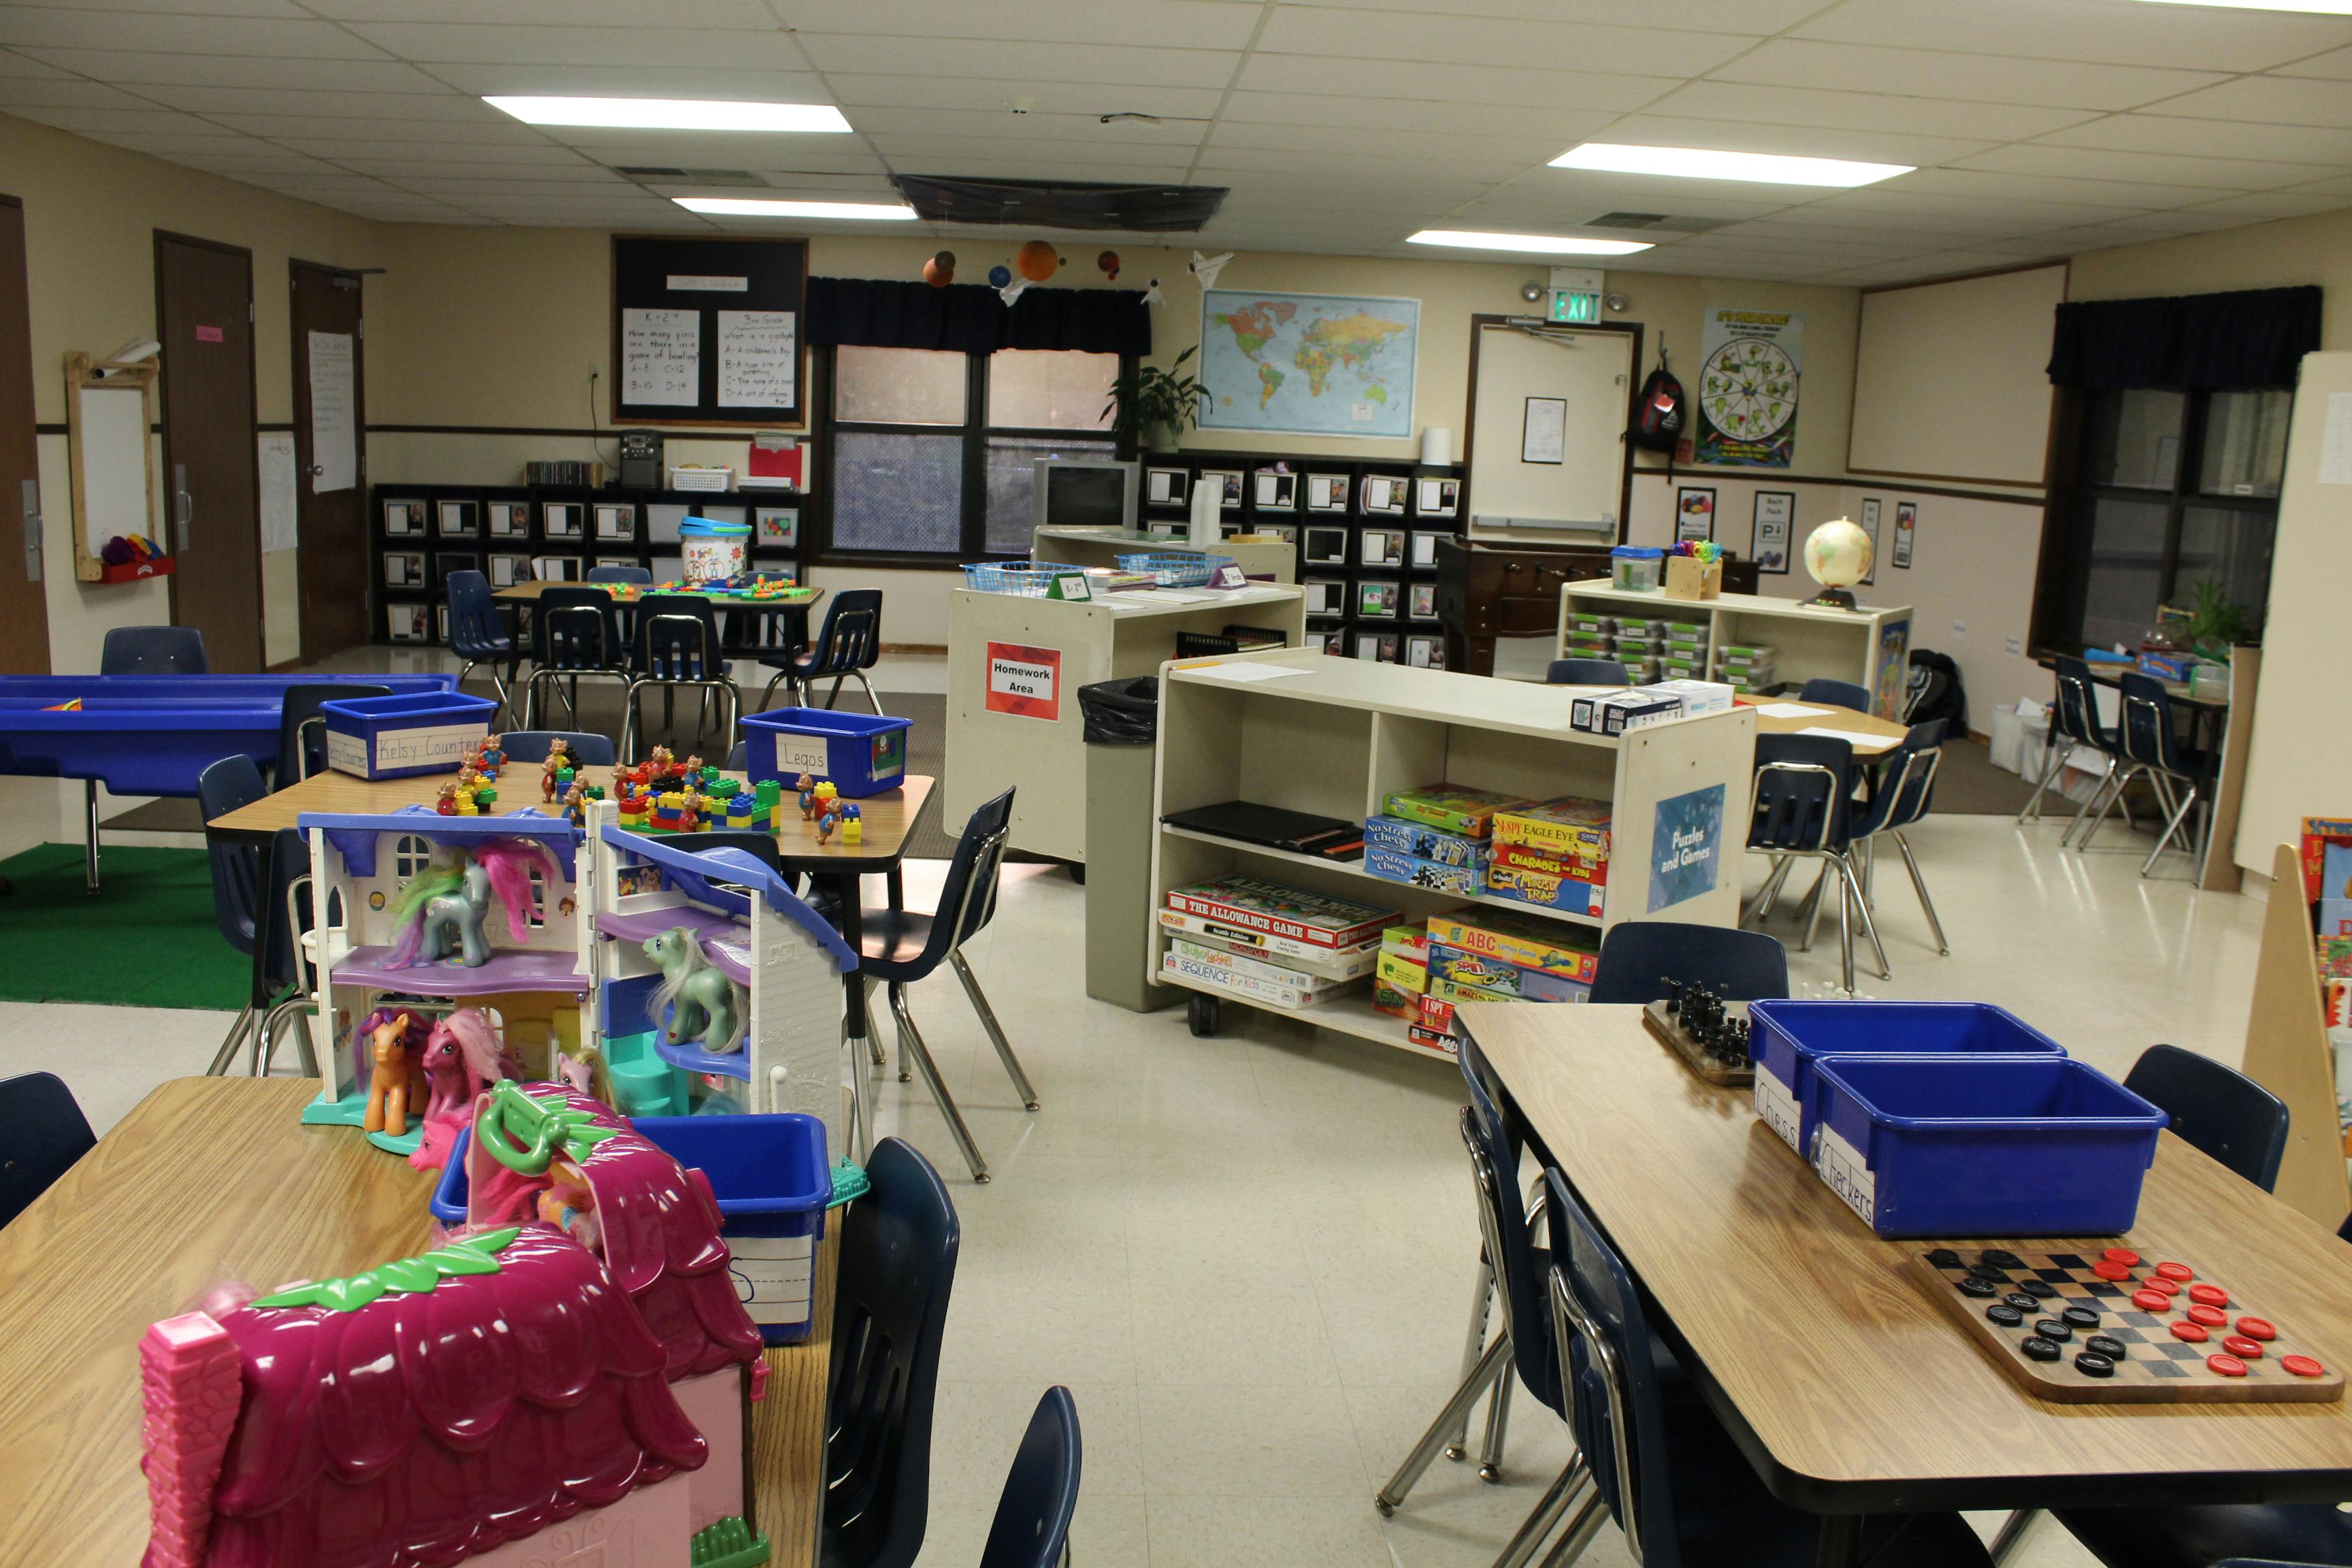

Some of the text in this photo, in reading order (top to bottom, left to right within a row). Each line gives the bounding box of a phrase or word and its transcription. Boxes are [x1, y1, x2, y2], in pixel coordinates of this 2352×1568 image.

[1556, 291, 1599, 321] EXIT
[645, 313, 651, 322] K
[628, 329, 694, 340] How many pins
[628, 353, 650, 362] game
[654, 349, 664, 359] of
[1763, 525, 1774, 539] P
[994, 663, 1050, 680] Homework
[1009, 682, 1034, 694] Area
[784, 743, 824, 773] Legos
[1367, 824, 1414, 843] No Stress
[1373, 832, 1406, 849] Chess
[1507, 821, 1522, 836] SPY
[1524, 824, 1554, 838] EAGLE
[1556, 830, 1574, 842] EYE
[1672, 826, 1704, 850] Puzzles
[1371, 853, 1414, 871] No Stress
[1377, 862, 1406, 877] Chess
[1508, 852, 1561, 874] CHARADES
[1571, 866, 1590, 879] KIDS
[1661, 847, 1710, 873] and Games
[1226, 876, 1379, 917] ALLOWANCE
[1524, 887, 1555, 903] TRAP
[1190, 900, 1209, 915] THE
[1211, 906, 1271, 930] ALLOWANCE
[1273, 921, 1304, 938] GAME
[1213, 928, 1250, 941] Seattle Edition
[1466, 931, 1537, 958] ABC Letter Game
[1181, 960, 1260, 990] SEQUENCE for kids
[1425, 1000, 1443, 1015] I SPY
[1757, 1082, 1796, 1147] Chess
[1821, 1143, 1872, 1222] Checkers
